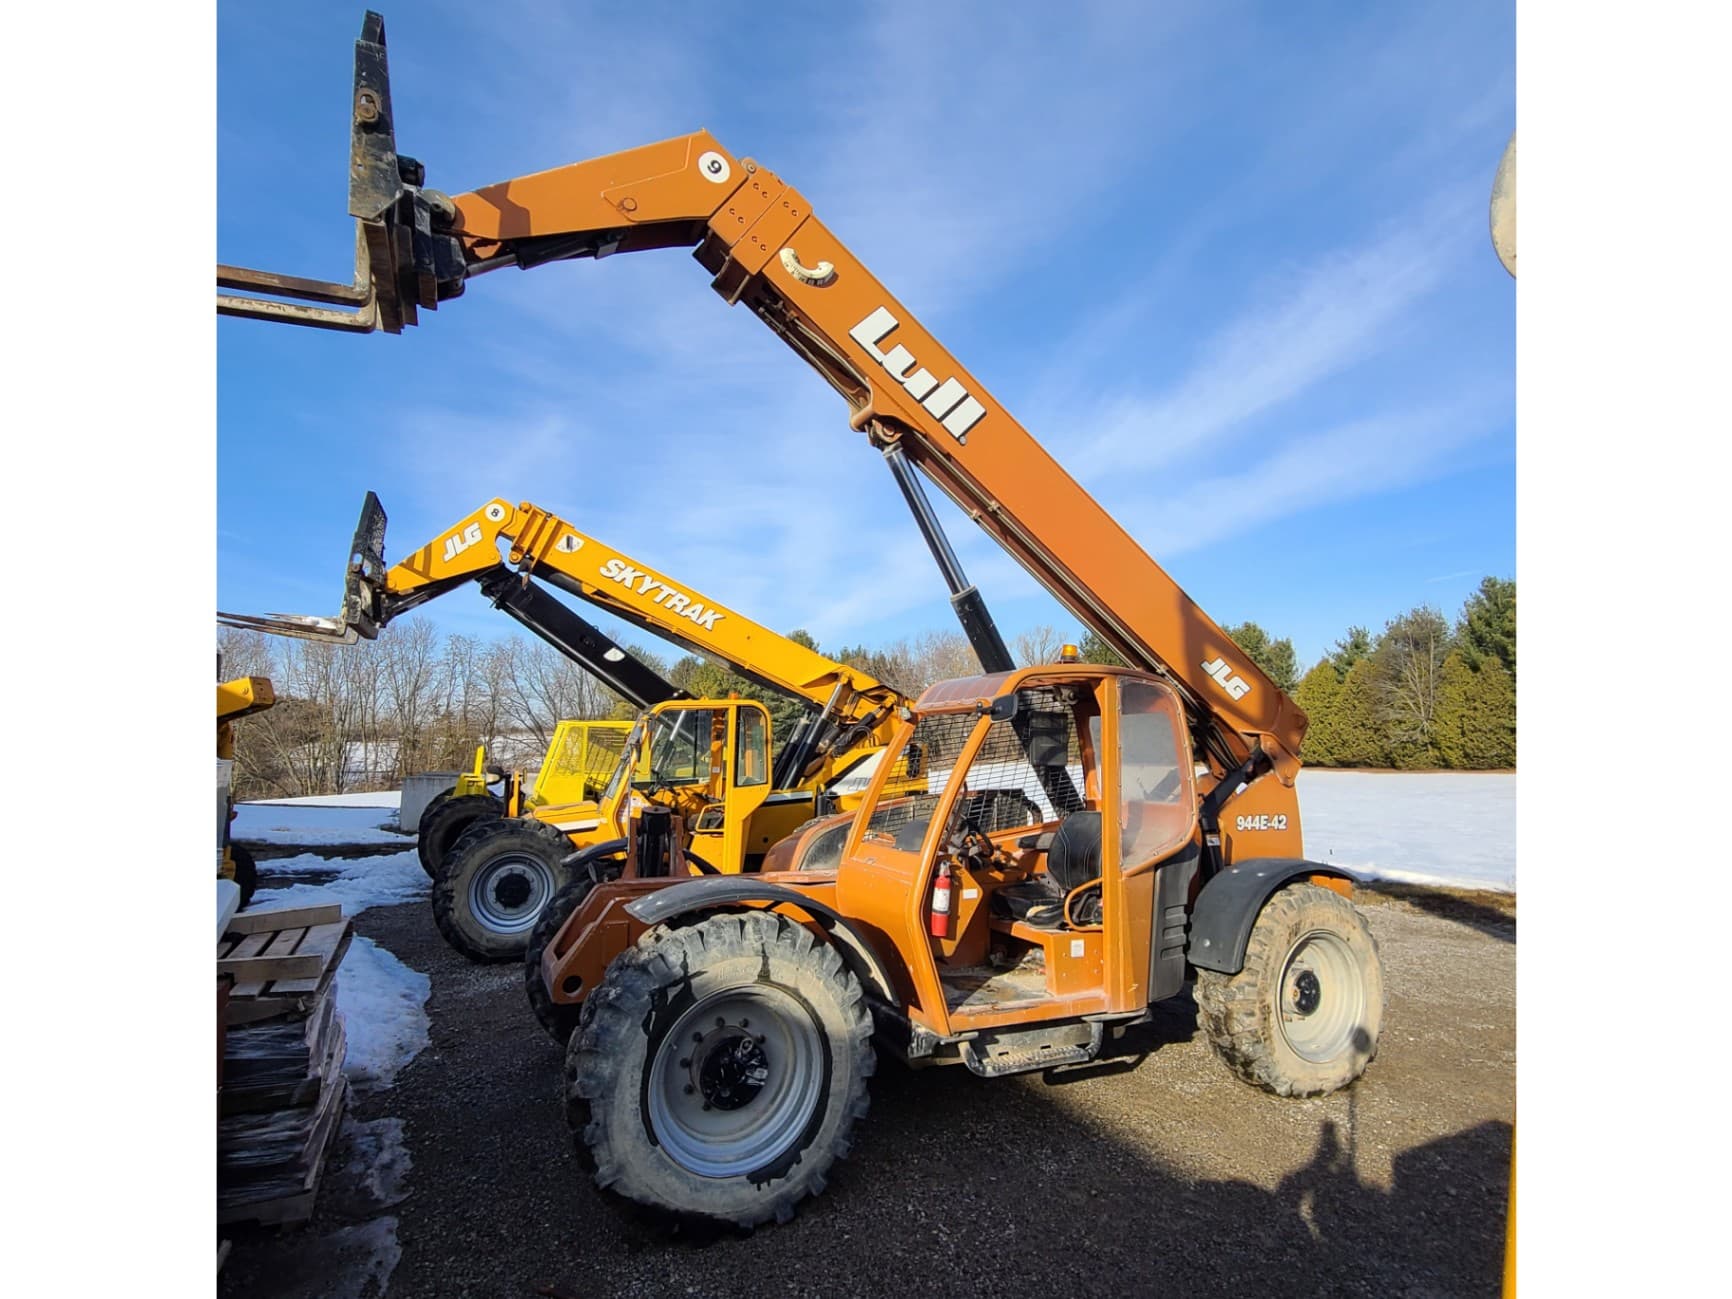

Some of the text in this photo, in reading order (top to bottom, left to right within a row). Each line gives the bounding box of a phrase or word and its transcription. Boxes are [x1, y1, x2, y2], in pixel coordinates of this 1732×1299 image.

[707, 159, 722, 174] 9
[848, 305, 987, 441] Lull
[490, 507, 500, 518] 8
[443, 522, 483, 562] JLG
[599, 559, 726, 631] SKYTRAK
[1200, 657, 1252, 702] JLG
[1236, 814, 1287, 831] 944E-42
